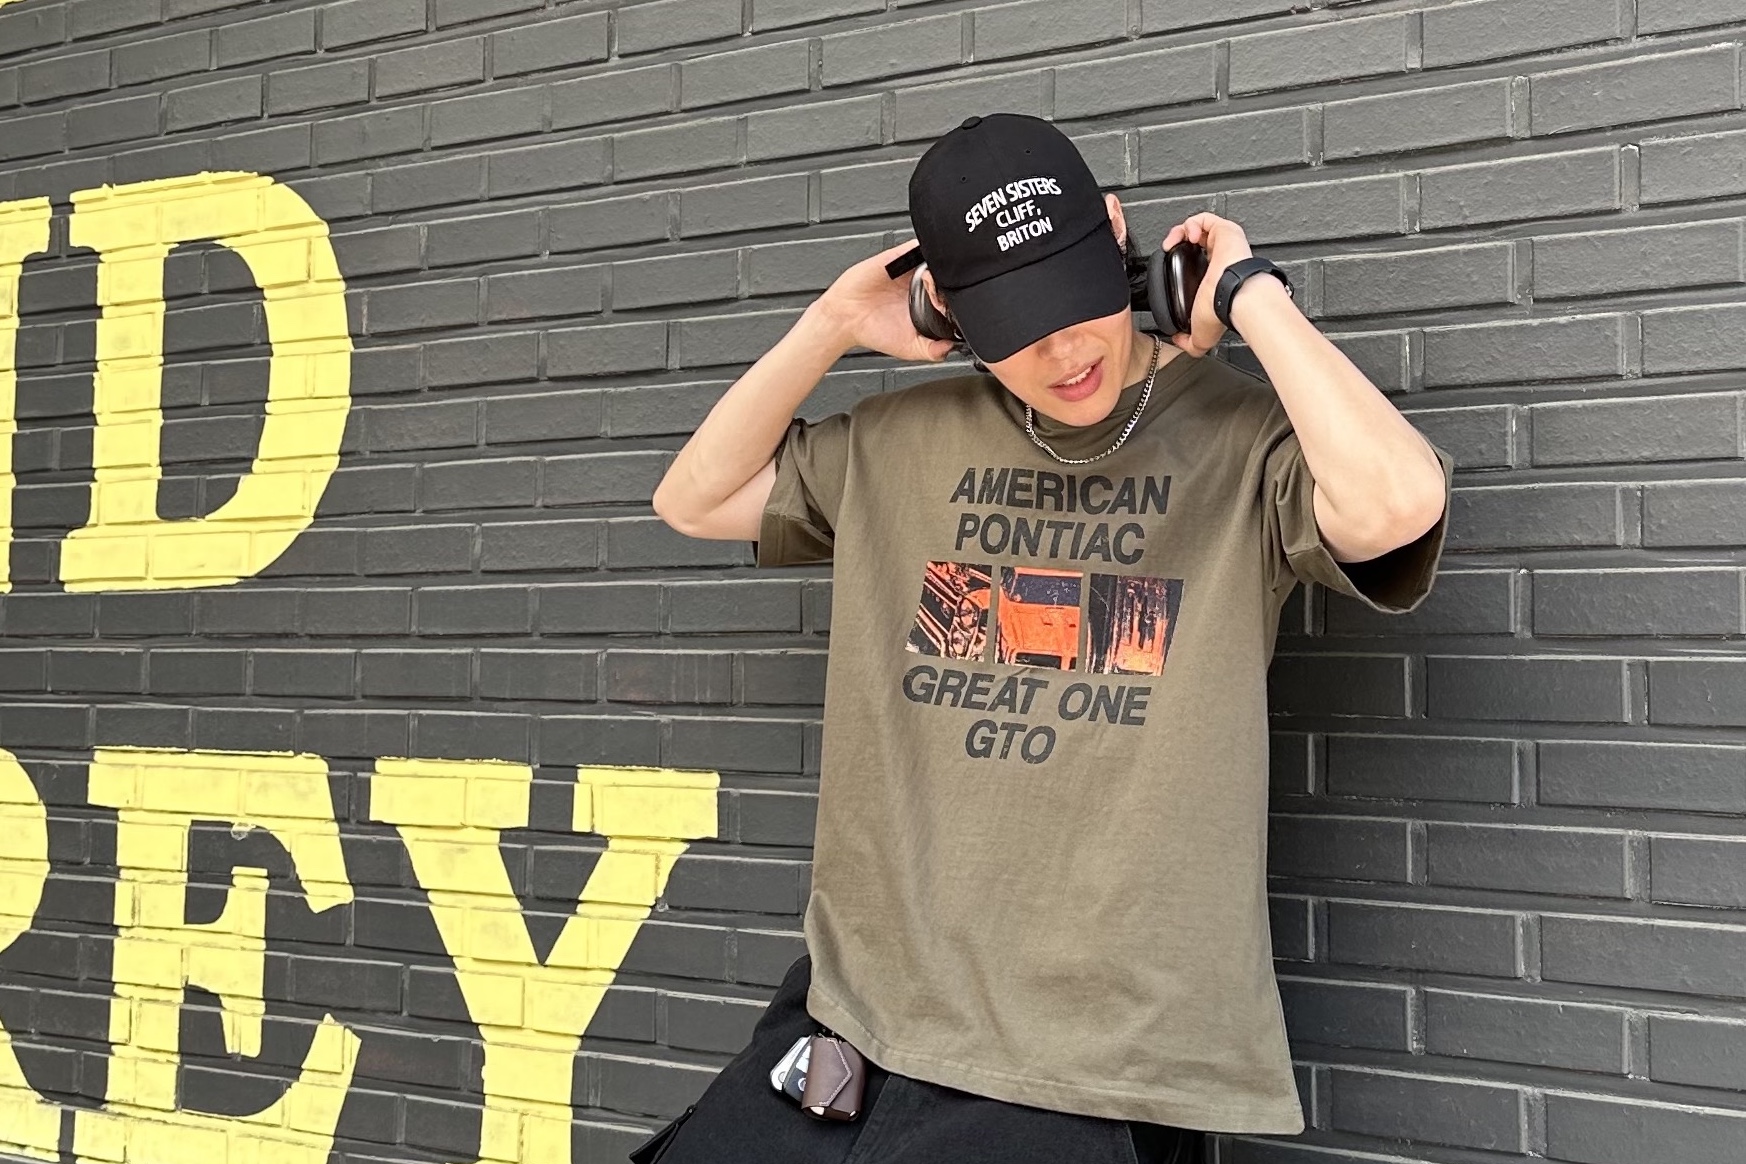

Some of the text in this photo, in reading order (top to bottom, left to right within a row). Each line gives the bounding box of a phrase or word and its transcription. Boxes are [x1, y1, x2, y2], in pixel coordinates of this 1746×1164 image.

[965, 177, 1062, 233] SEVEN SISTERS
[995, 199, 1042, 228] CLIFF,
[996, 216, 1054, 252] BRITON
[949, 466, 1172, 516] AMERICAN
[954, 512, 1145, 566] PONTIAC
[902, 664, 1152, 726] GREAT ONE
[964, 718, 1056, 765] GTO
